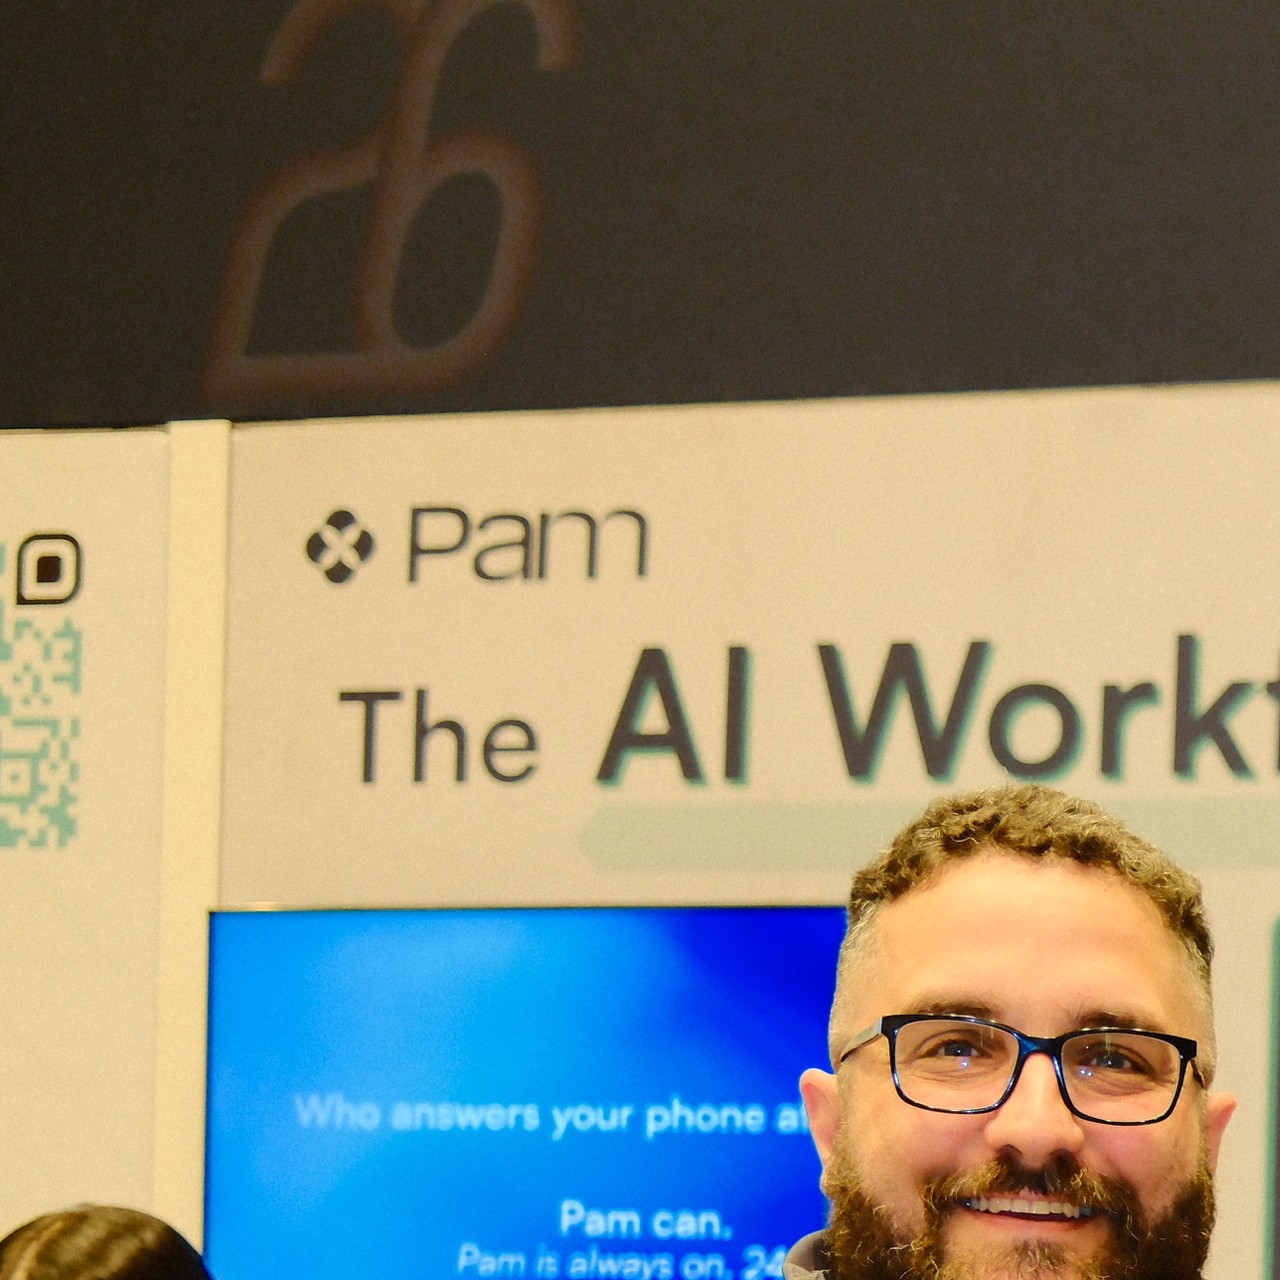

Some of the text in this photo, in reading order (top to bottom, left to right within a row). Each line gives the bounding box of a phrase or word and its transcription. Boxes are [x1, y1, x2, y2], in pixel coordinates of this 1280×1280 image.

[408, 505, 650, 583] Pam
[339, 689, 539, 783] The
[595, 645, 752, 785] AI
[295, 1092, 380, 1131] Who
[391, 1100, 541, 1131] answers
[551, 1104, 634, 1141] your
[645, 1093, 766, 1143] phone
[559, 1198, 734, 1240] Pam can.
[457, 1242, 526, 1274] Pam
[537, 1243, 559, 1277] is
